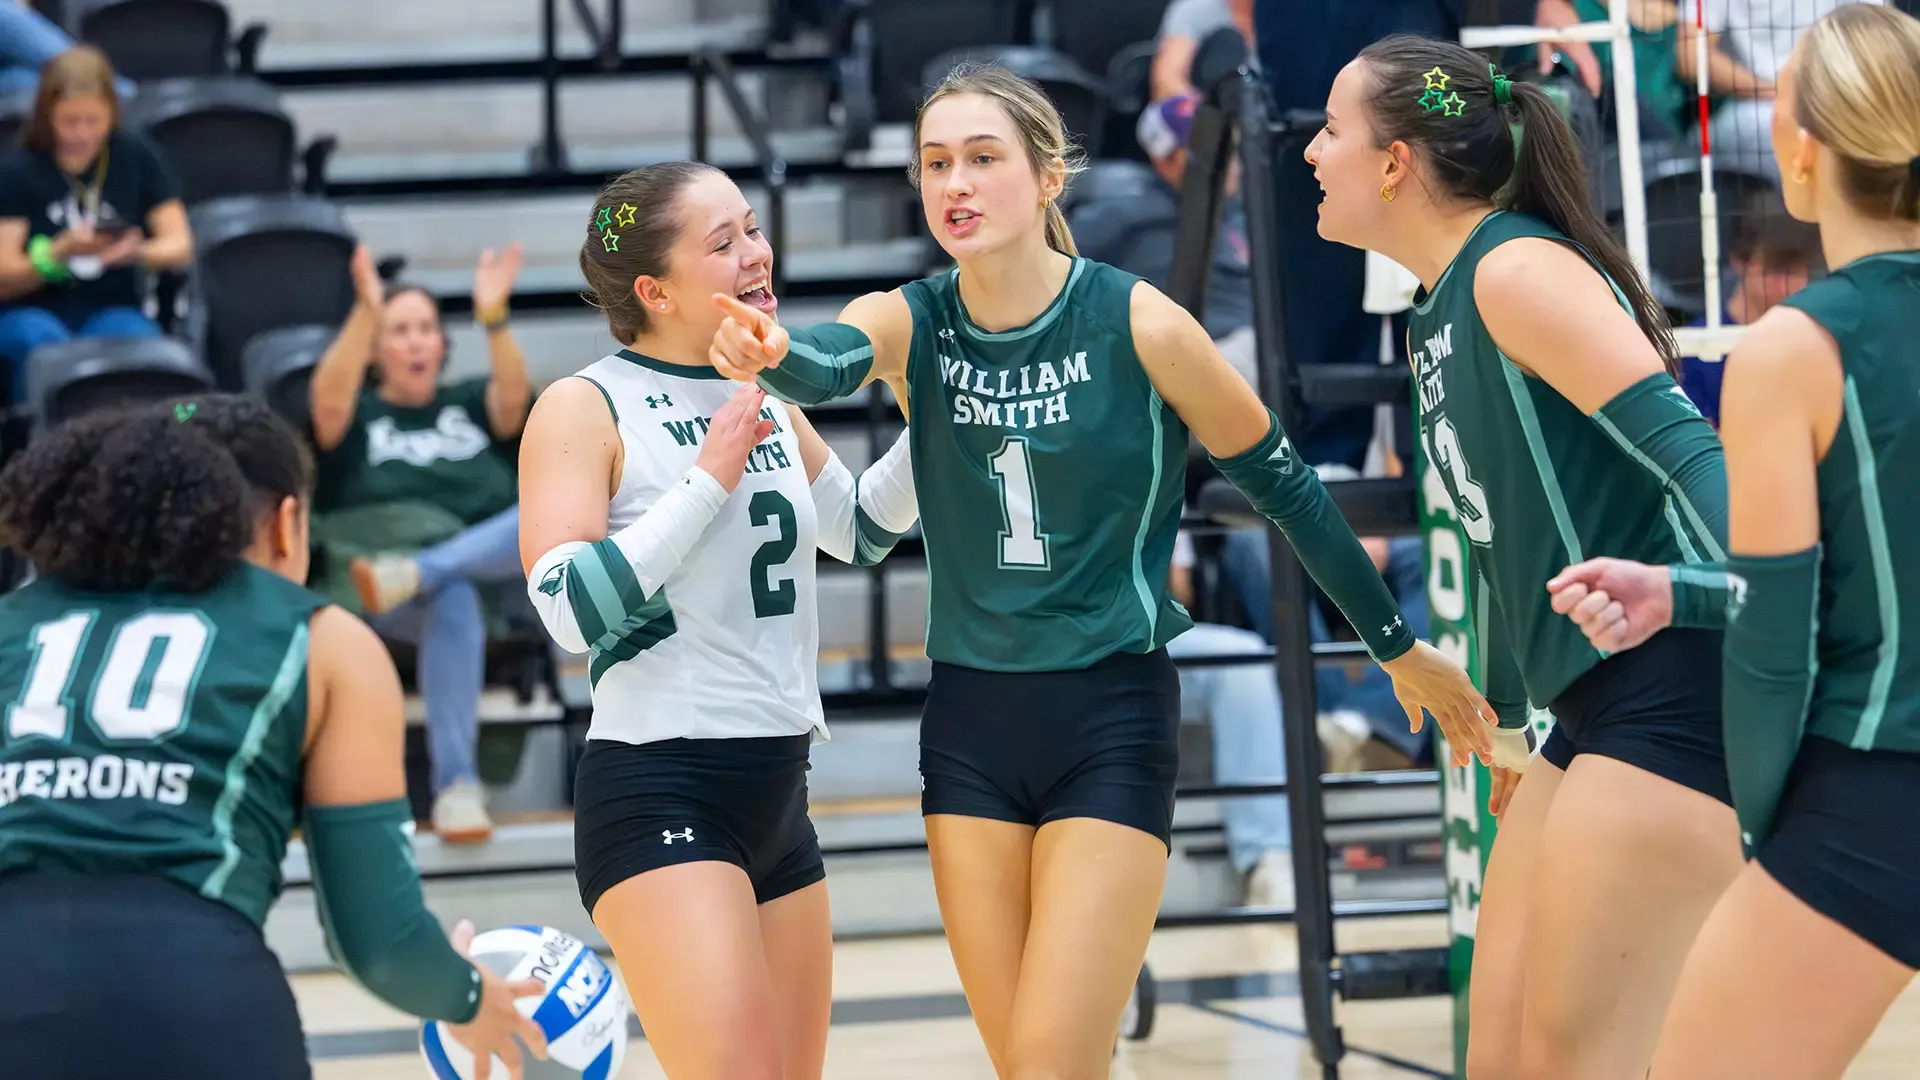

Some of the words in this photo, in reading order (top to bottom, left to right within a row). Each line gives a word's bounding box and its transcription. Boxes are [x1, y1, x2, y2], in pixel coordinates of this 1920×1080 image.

[938, 351, 1092, 399] WILLIAM
[953, 391, 1071, 430] SMITH
[744, 440, 792, 474] ITH
[986, 435, 1051, 571] 1
[748, 489, 798, 619] 2
[4, 607, 218, 747] 10
[0, 754, 195, 808] HERONS
